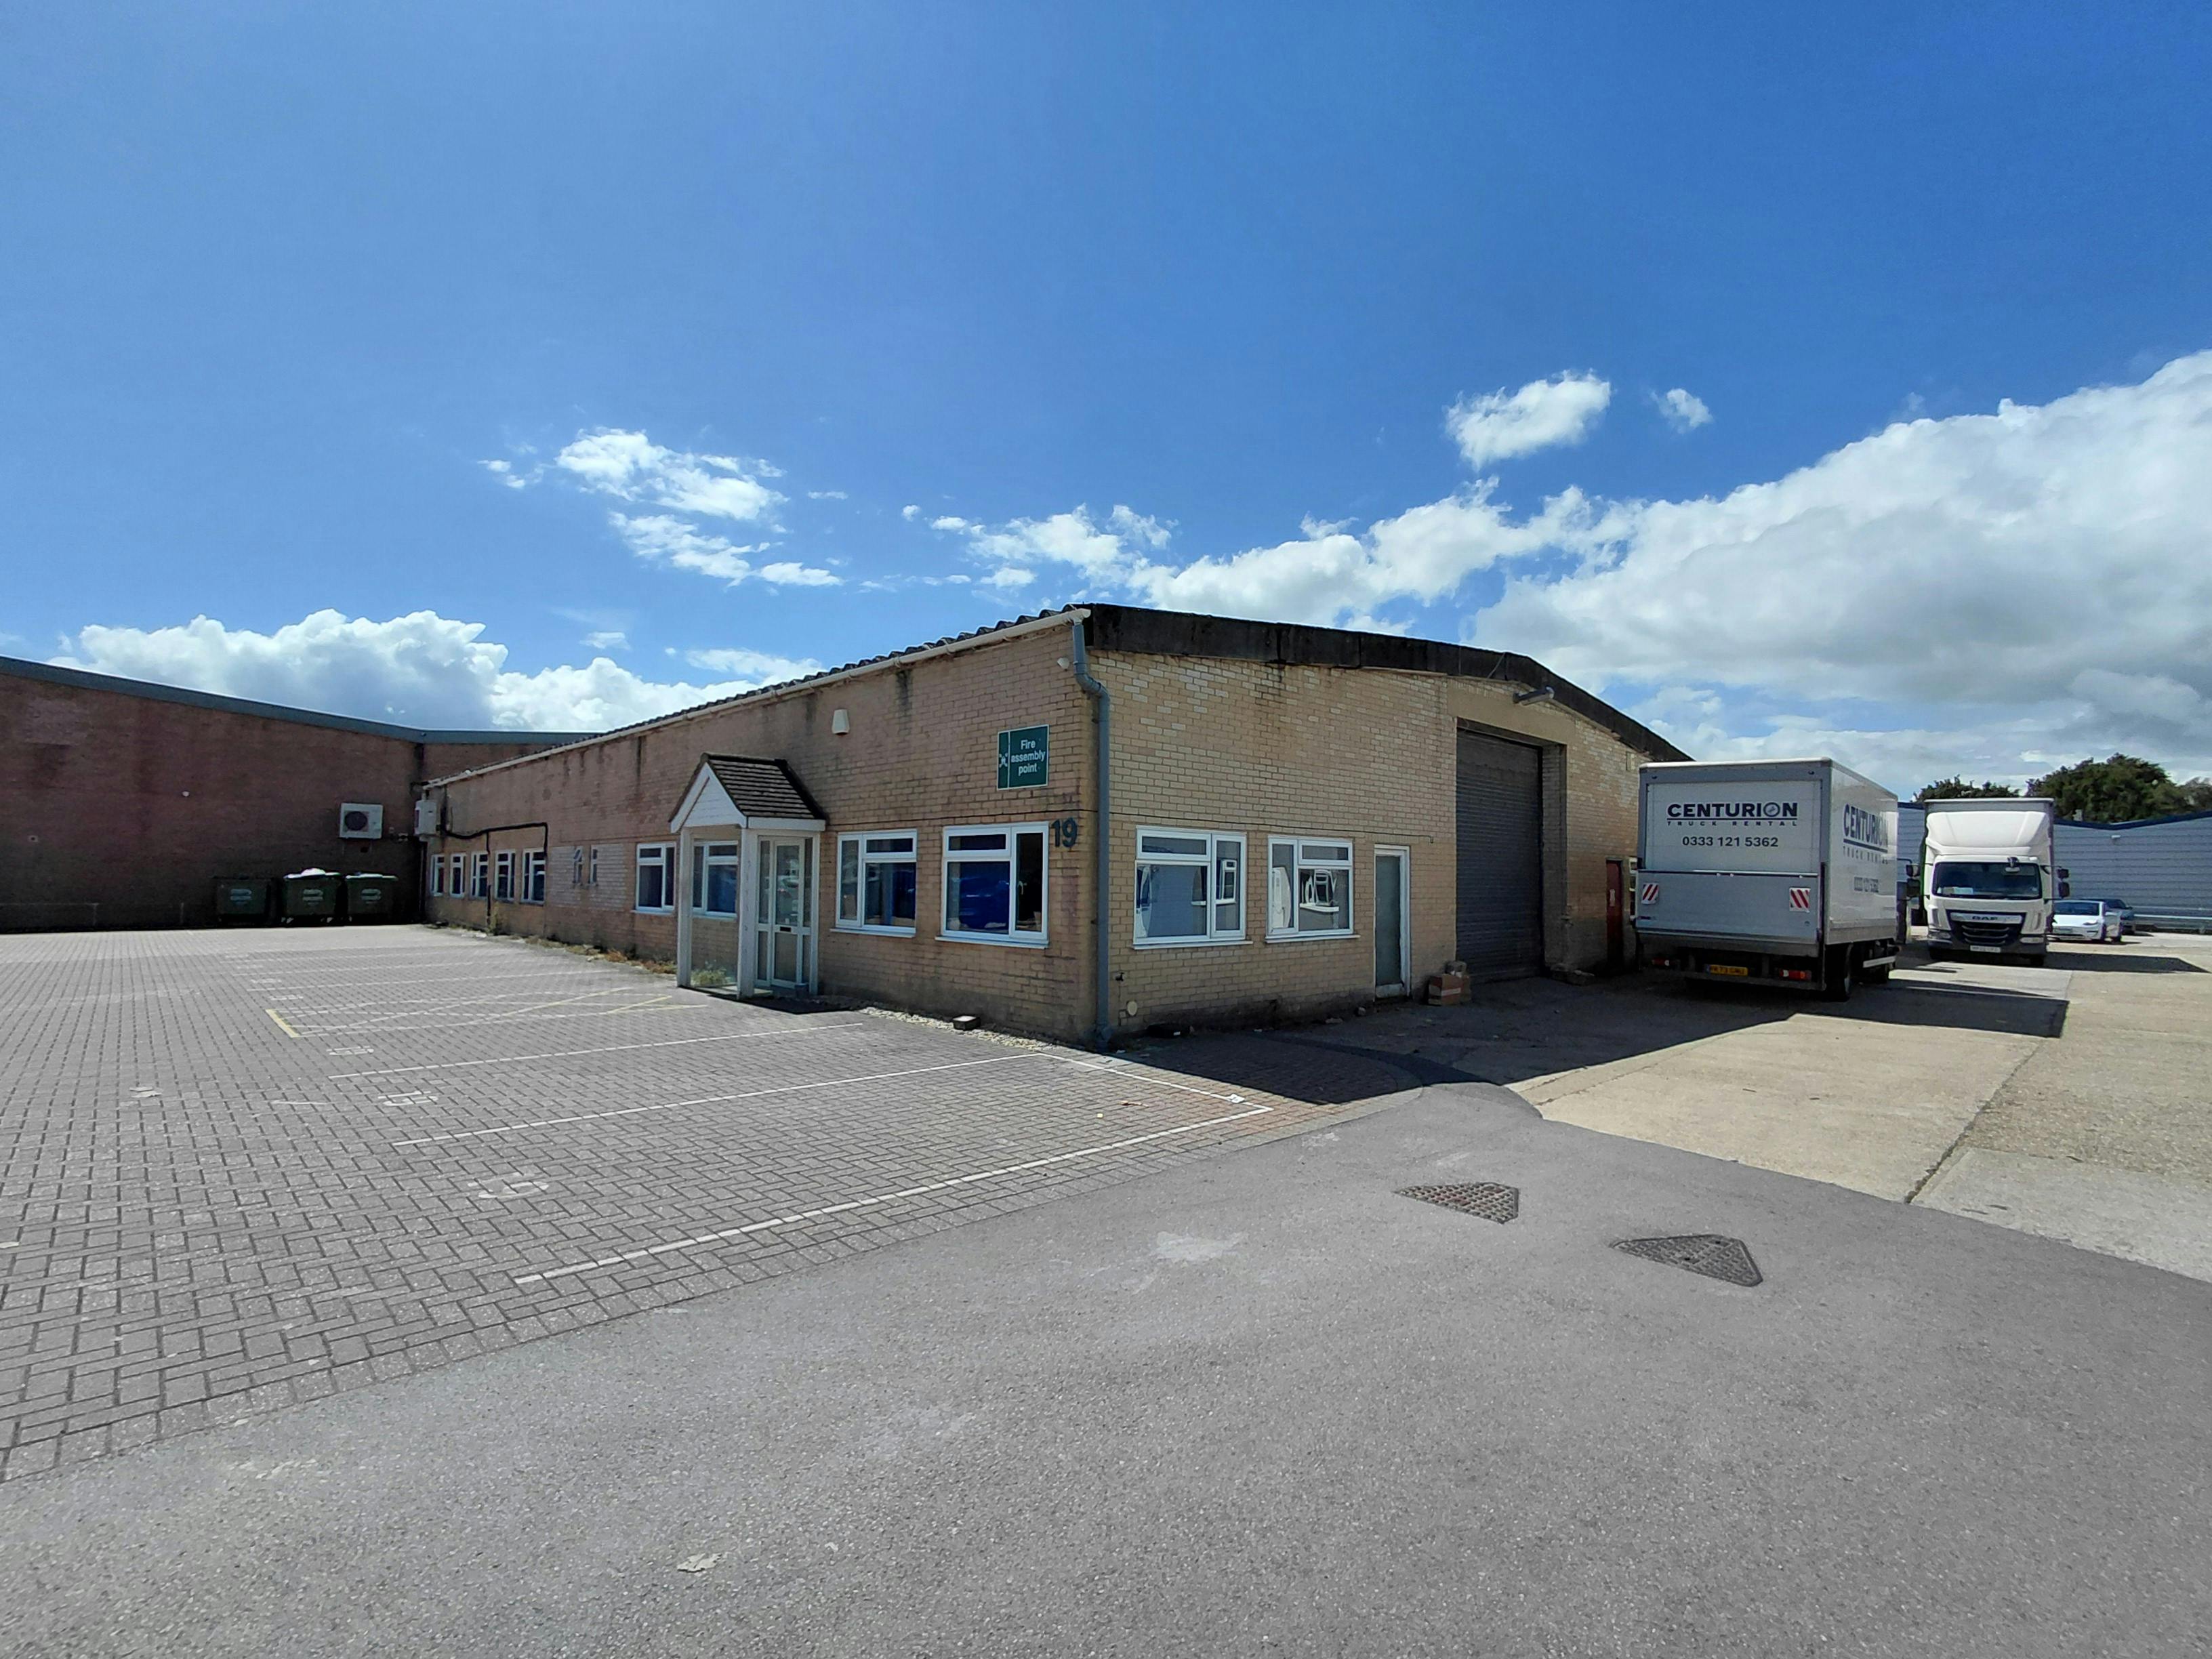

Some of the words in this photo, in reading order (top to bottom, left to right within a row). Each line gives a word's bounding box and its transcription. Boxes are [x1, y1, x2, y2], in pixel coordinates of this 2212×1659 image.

[1021, 739, 1036, 749] Fire
[1010, 750, 1046, 763] assembly
[1018, 762, 1037, 776] point
[1667, 802, 1797, 817] CENTURION
[1051, 817, 1078, 848] 19
[1682, 836, 1713, 846] 0333
[1717, 837, 1740, 846] 121
[1744, 837, 1778, 847] 5362
